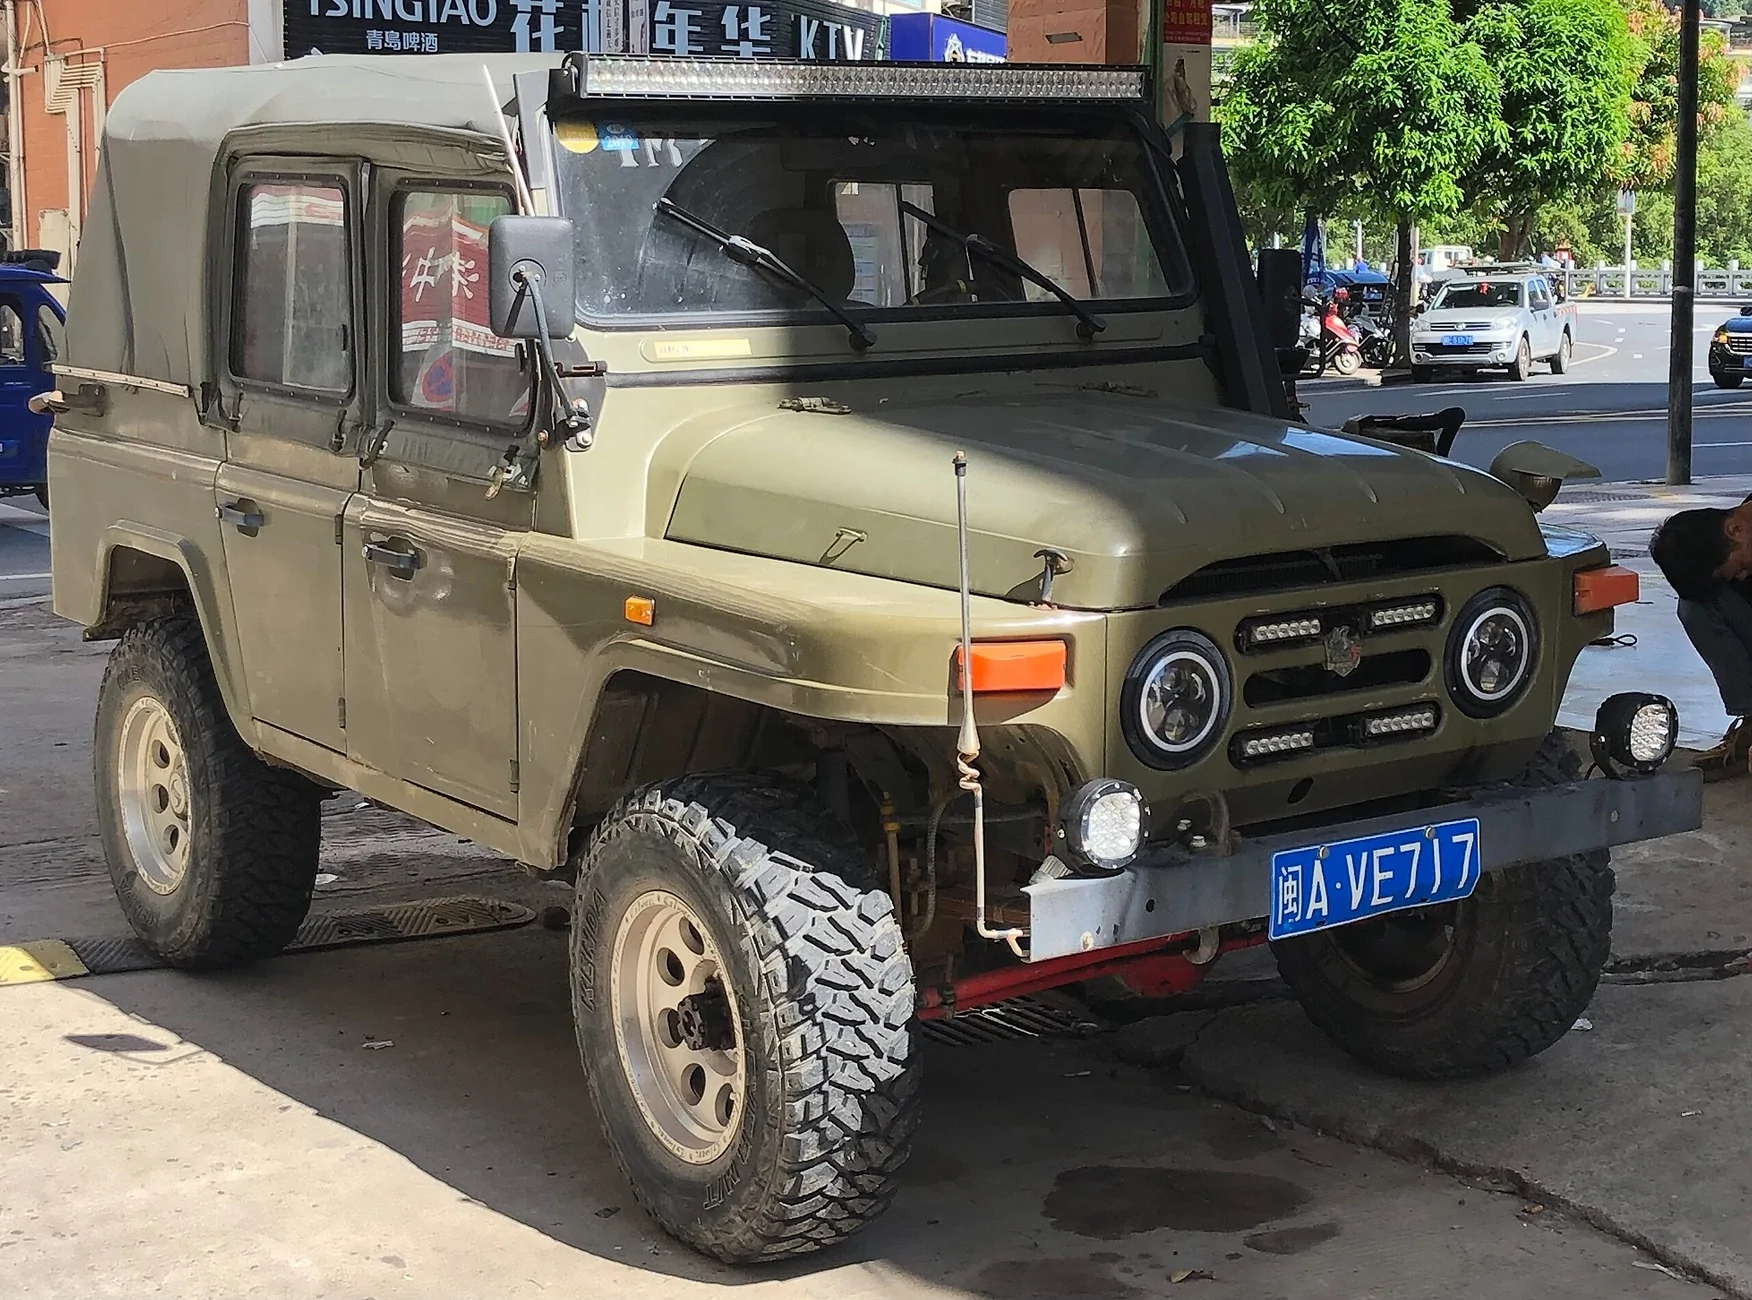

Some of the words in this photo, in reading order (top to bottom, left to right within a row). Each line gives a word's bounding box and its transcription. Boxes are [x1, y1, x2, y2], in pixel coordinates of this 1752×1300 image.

[366, 30, 438, 52] 青岛啤酒
[800, 14, 865, 60] KTV
